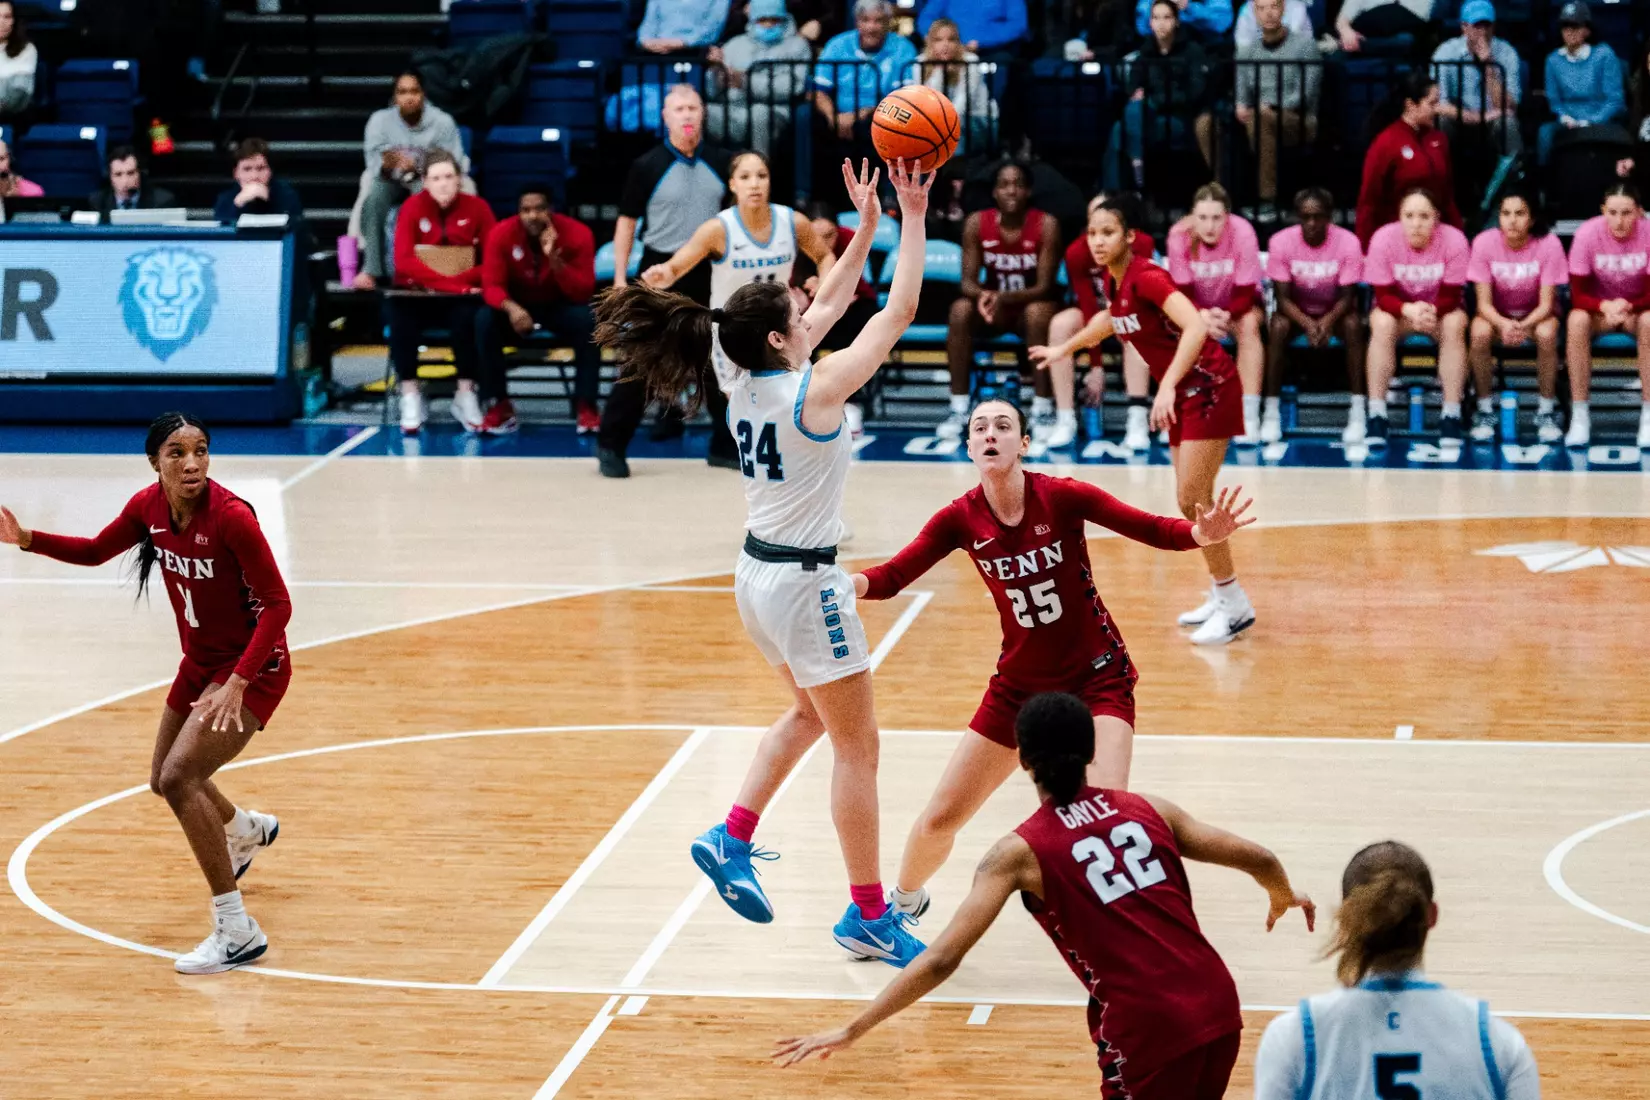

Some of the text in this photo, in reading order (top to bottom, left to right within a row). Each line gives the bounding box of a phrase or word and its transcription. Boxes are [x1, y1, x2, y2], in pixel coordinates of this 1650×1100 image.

[983, 252, 1037, 271] PENN
[736, 418, 785, 482] 24
[976, 539, 1064, 581] PENN
[820, 588, 849, 659] LIONS
[1004, 578, 1063, 629] 25
[1055, 793, 1119, 830] GAYLE
[1071, 820, 1168, 905] 22
[1386, 1010, 1401, 1031] C
[1372, 1051, 1423, 1100] 5
